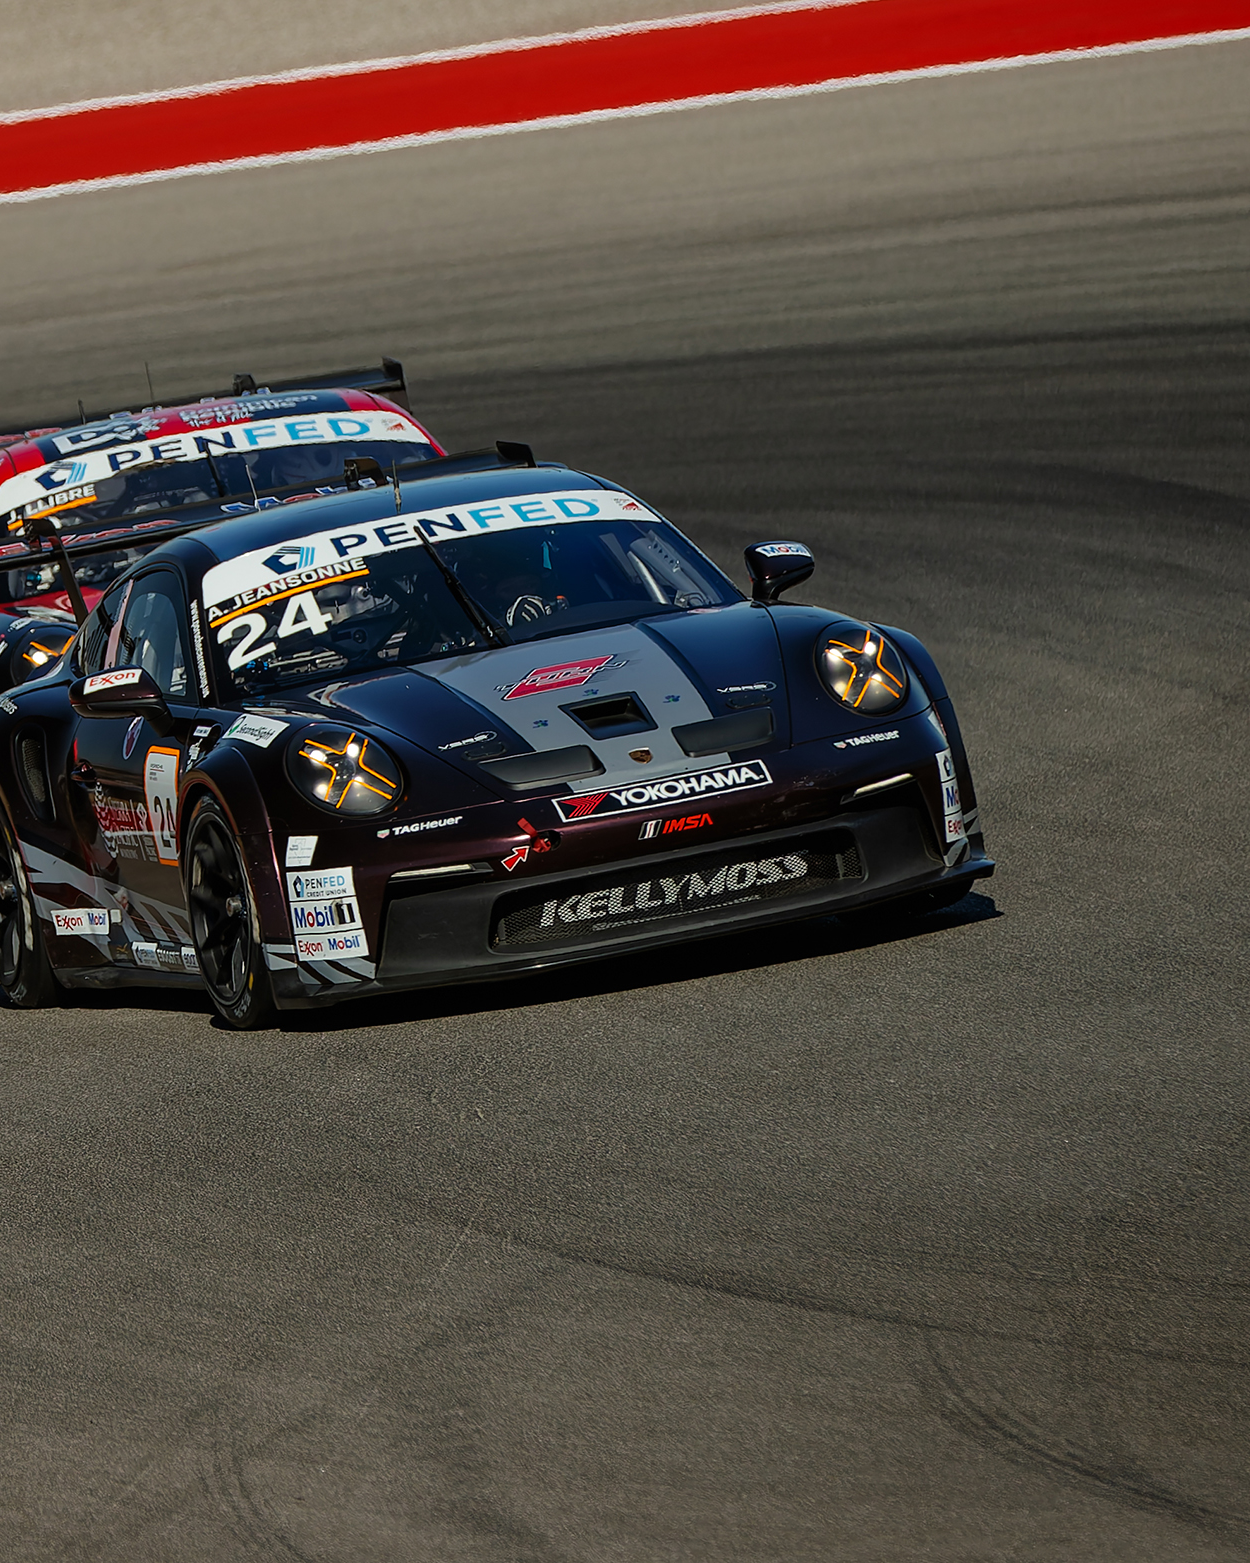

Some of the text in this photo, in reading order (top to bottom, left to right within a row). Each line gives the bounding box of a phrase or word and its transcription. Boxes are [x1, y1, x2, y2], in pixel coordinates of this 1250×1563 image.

[107, 417, 372, 472] PENFED
[7, 484, 96, 527] J. LLIBRE
[330, 497, 601, 558] PENFED
[208, 556, 368, 622] A. JEANSONNE
[217, 590, 333, 672] 24
[89, 670, 137, 688] Exxon
[610, 768, 762, 806] YOKOHAMA
[153, 796, 177, 848] 24
[662, 814, 714, 834] IMSA
[305, 875, 346, 890] PENFED
[306, 887, 348, 898] CREDIT UNION
[540, 854, 809, 929] KELLYMOSS
[55, 912, 107, 931] Exxon Mobil
[293, 905, 335, 929] Mobil
[298, 936, 359, 956] Exxon Mobil
